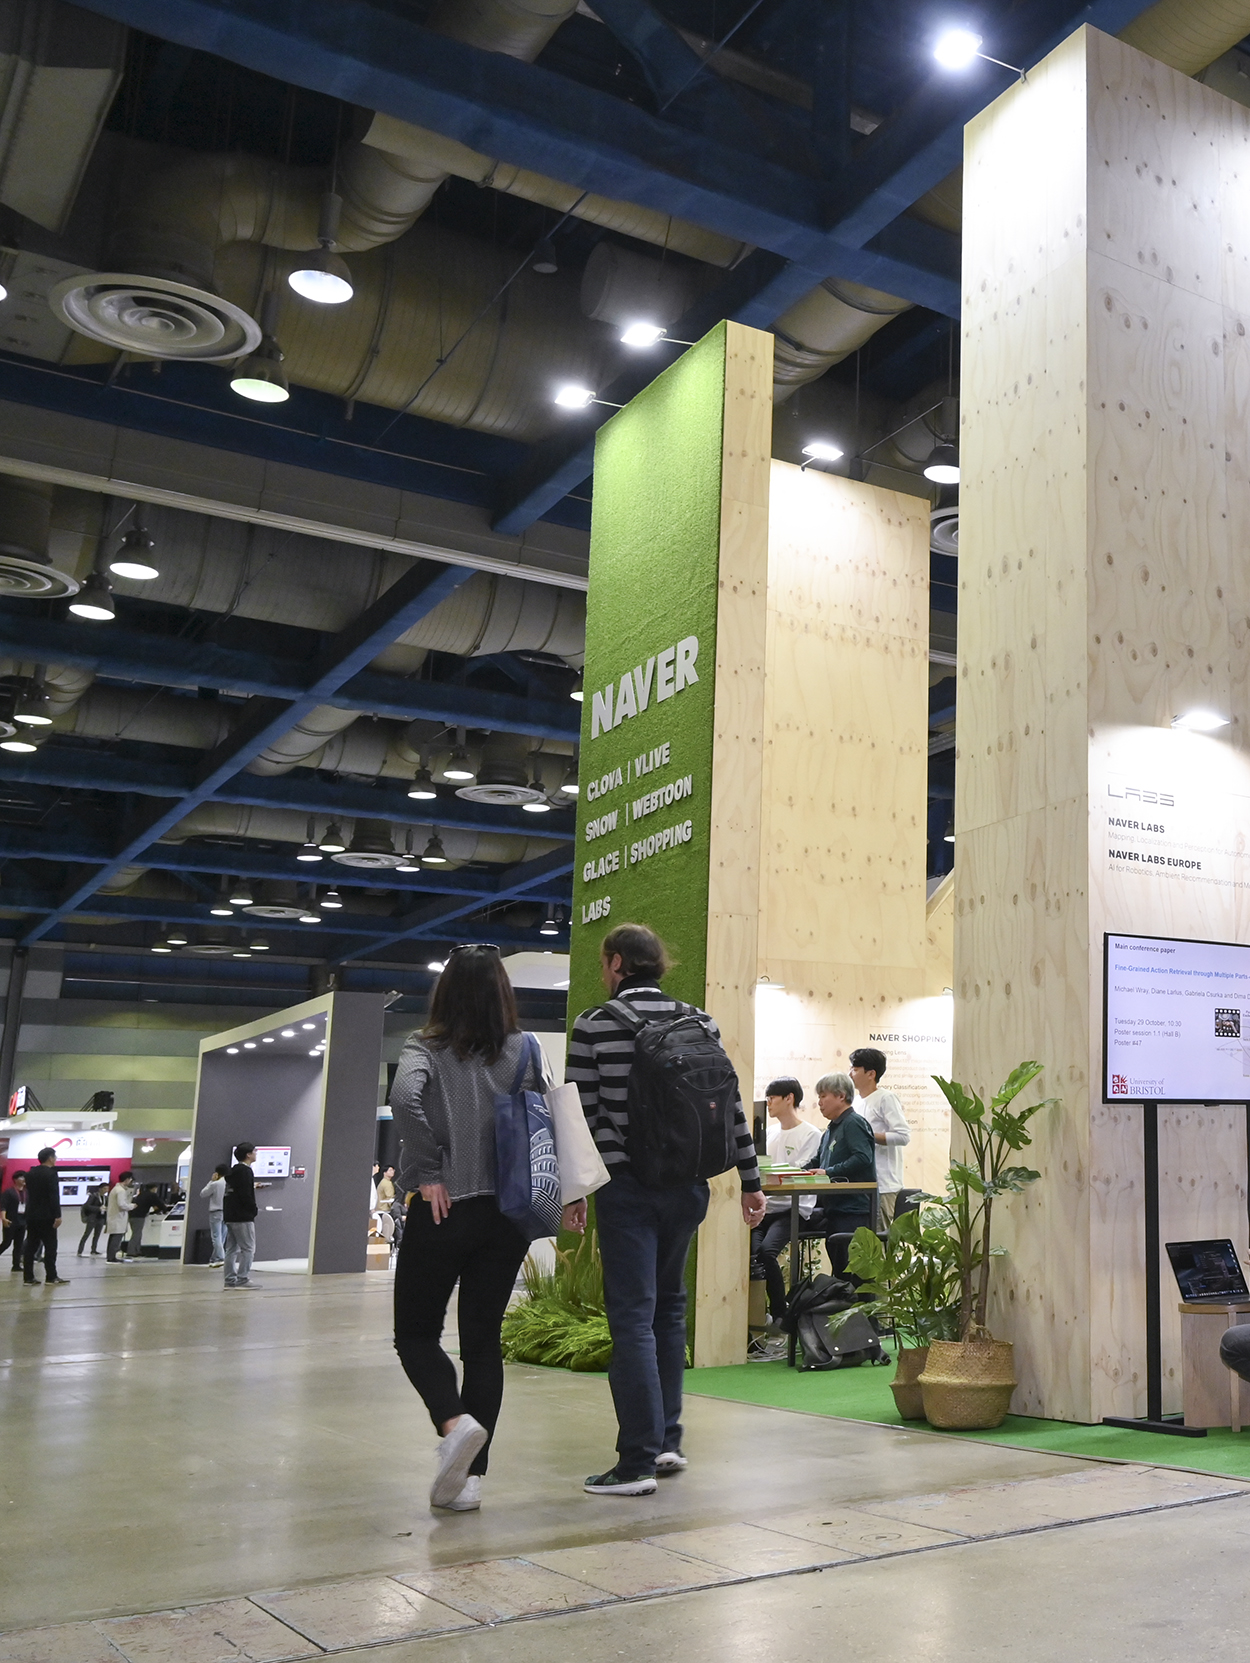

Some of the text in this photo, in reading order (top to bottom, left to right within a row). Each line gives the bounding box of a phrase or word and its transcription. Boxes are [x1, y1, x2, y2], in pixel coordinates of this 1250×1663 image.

[591, 635, 700, 740] NAVER
[587, 742, 670, 802] CLOVA VLIVE
[1108, 784, 1174, 807] LABS
[586, 774, 692, 842] SNOW WEBTOON
[1108, 817, 1165, 834] NAVER LABS
[583, 820, 692, 882] GLACE SHOPPING
[1184, 843, 1215, 855] Perception
[1108, 849, 1202, 870] NAVER LABS EUROPE
[1116, 864, 1124, 873] for
[1155, 870, 1180, 881] Ambient
[1181, 874, 1232, 888] Recommendation
[1233, 880, 1243, 888] and
[582, 896, 611, 924] LABS
[1129, 944, 1159, 953] conference
[1115, 964, 1150, 973] Fine-Grained
[1169, 968, 1192, 976] Retrieval
[1193, 970, 1213, 978] through
[1214, 971, 1234, 979] Multiple
[1115, 1018, 1136, 1026] Tuesday
[902, 1034, 946, 1043] SHOPPING
[1130, 1078, 1157, 1086] University
[1130, 1086, 1165, 1095] BRISTOL
